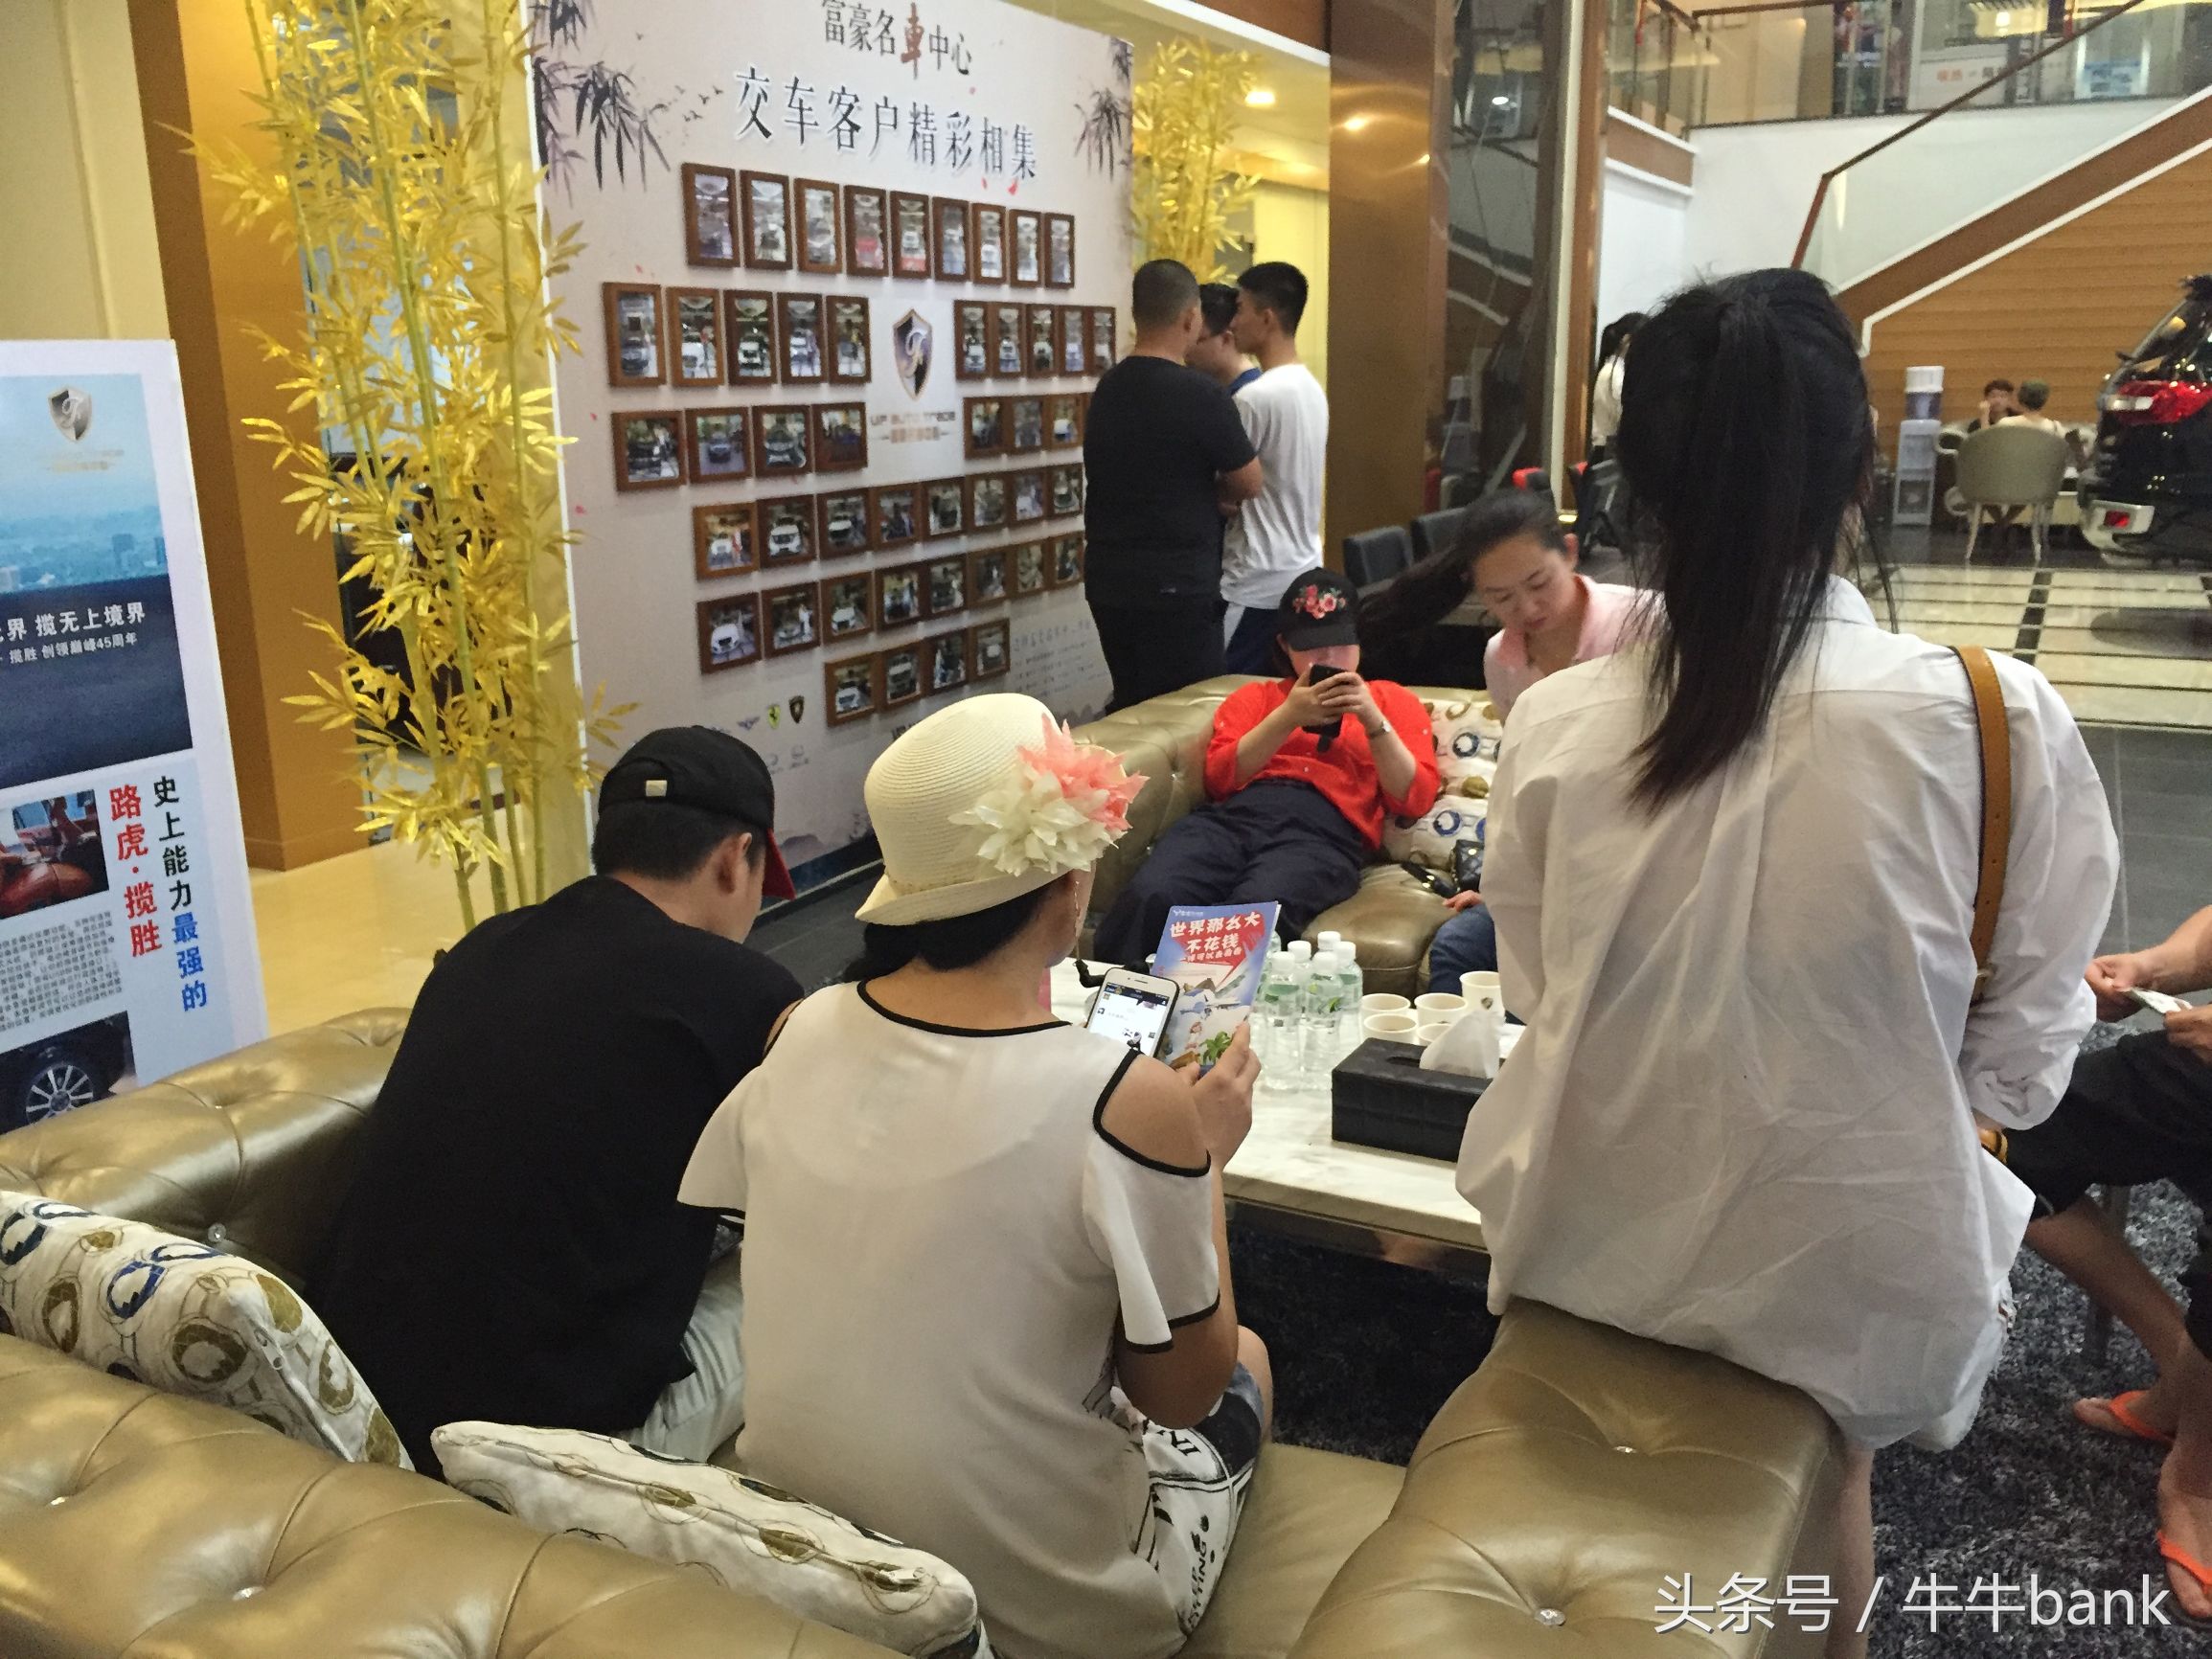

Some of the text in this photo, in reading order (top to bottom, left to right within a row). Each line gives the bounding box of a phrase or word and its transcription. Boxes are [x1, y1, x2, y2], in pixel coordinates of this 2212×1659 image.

[736, 65, 1036, 180] 交车客户精彩相集
[34, 601, 146, 637] 揽无上境界
[153, 775, 208, 1012] 史上能力最强的
[1170, 911, 1262, 938] 世界那么大
[1186, 933, 1240, 954] 不花钱
